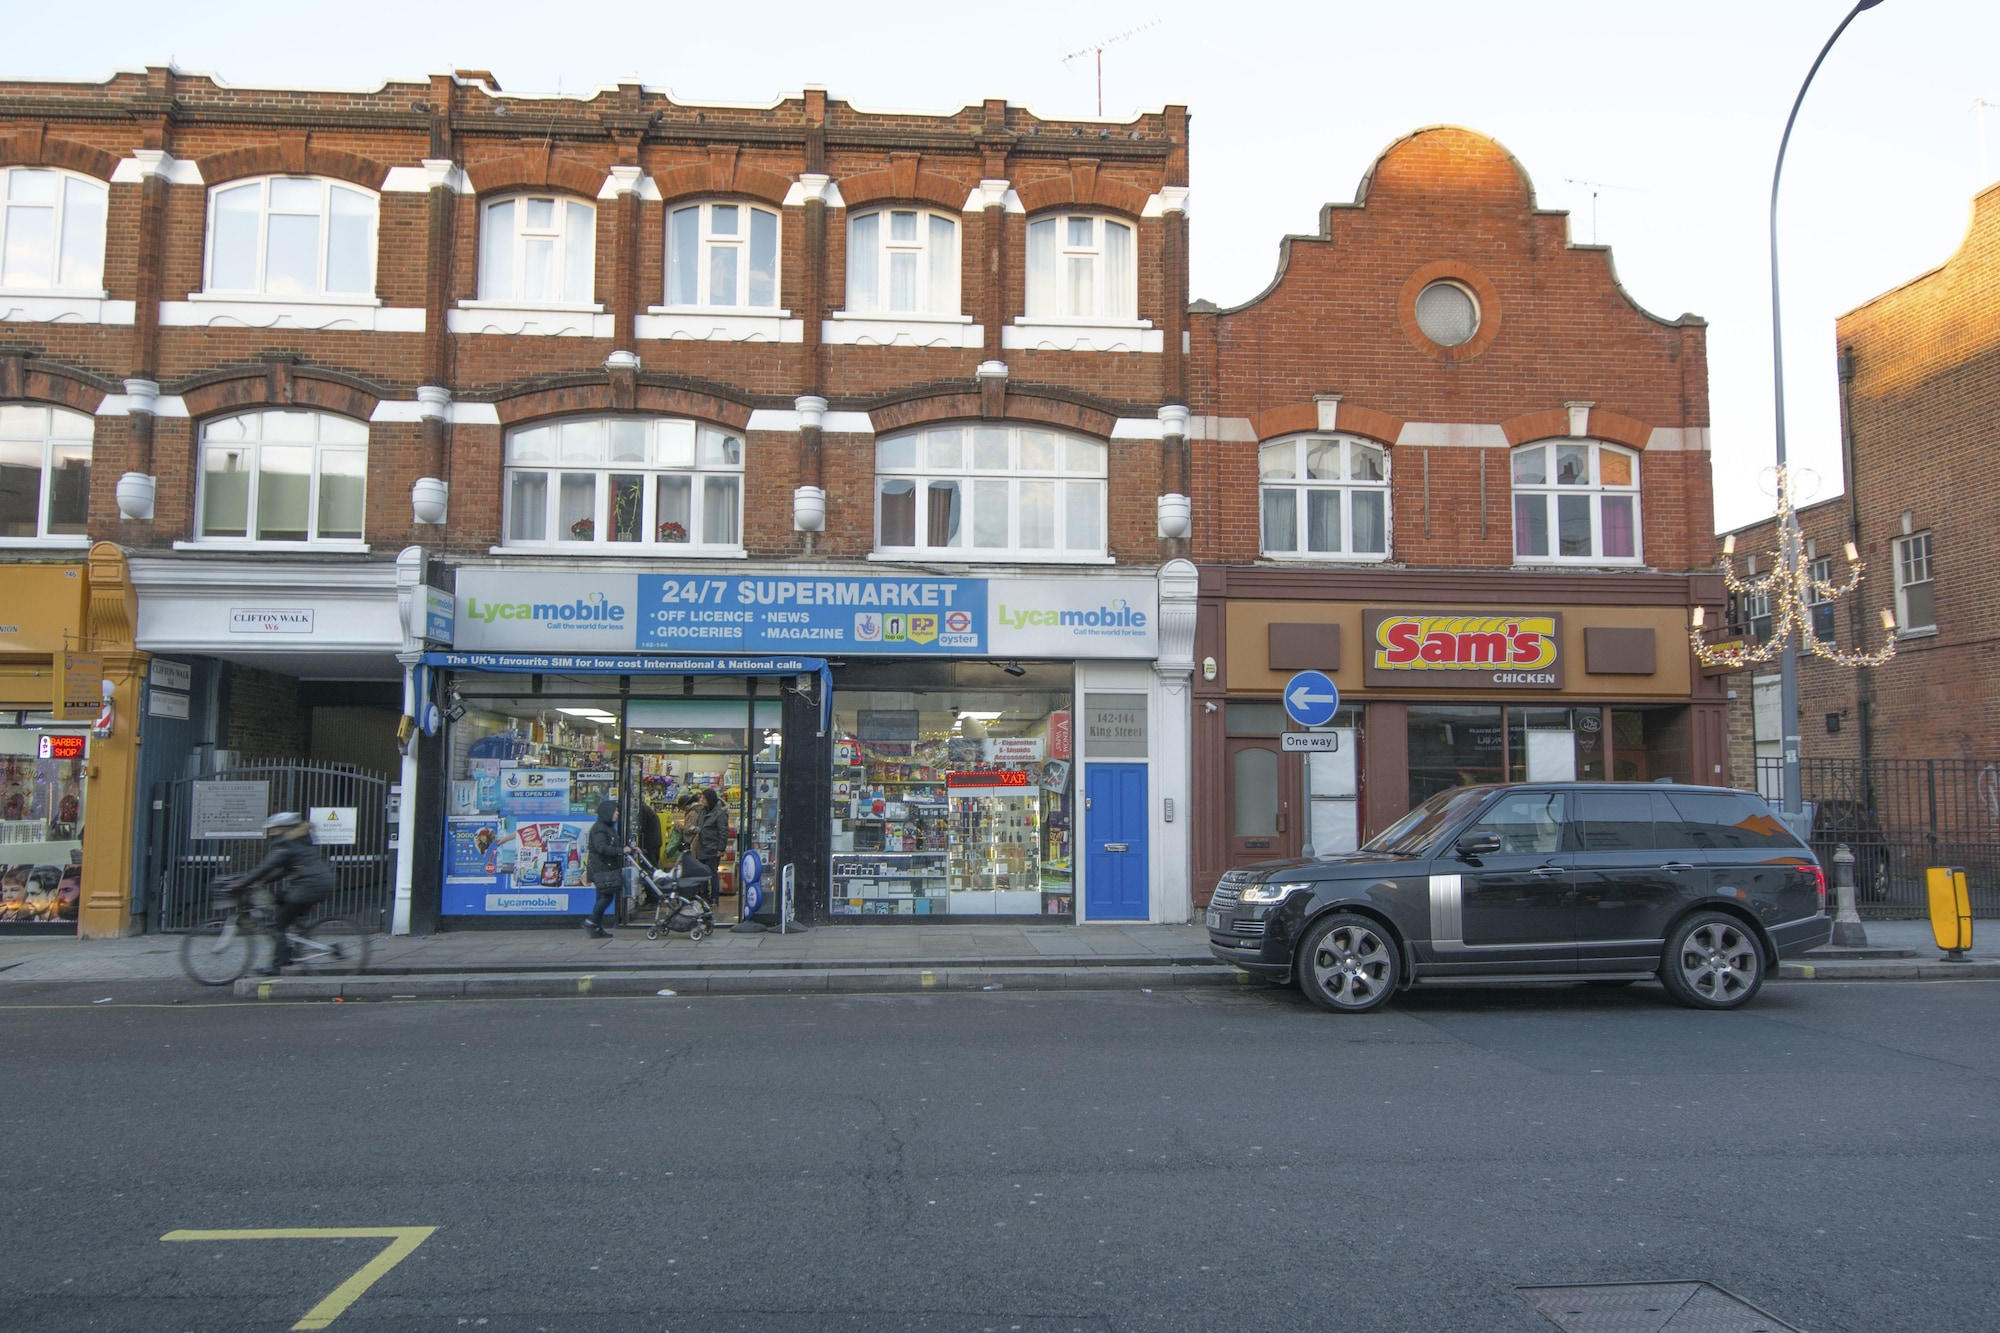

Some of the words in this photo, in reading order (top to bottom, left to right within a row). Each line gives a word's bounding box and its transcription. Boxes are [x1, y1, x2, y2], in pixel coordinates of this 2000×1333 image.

[662, 580, 727, 604] 24/7
[737, 581, 958, 606] SUPERMARKET
[467, 597, 625, 623] Lycamobile
[234, 614, 278, 622] CLIFTON
[280, 615, 308, 623] WALK
[657, 610, 686, 622] OFF
[690, 611, 754, 623] LICENCE
[767, 611, 810, 623] NEWS
[999, 604, 1146, 630] Lycamobile
[264, 623, 279, 631] W6
[547, 622, 562, 630] Call
[656, 626, 743, 638] GROCERIES
[767, 628, 844, 639] MAGAZINE
[940, 635, 974, 646] oyster
[1386, 622, 1543, 664] Sam's
[446, 655, 468, 664] The
[471, 656, 496, 665] UK's
[499, 656, 549, 666] favourite
[551, 657, 573, 667] SIM
[575, 657, 592, 667] for
[594, 658, 614, 667] low
[617, 660, 641, 668] cost
[644, 660, 714, 669] International
[717, 660, 726, 669] &
[728, 660, 774, 669] National
[776, 660, 803, 669] calls
[1493, 673, 1555, 684] CHICKEN
[1097, 713, 1135, 723] 142-144
[1090, 726, 1112, 738] King
[1114, 726, 1142, 737] Street
[50, 738, 82, 747] BARBER
[1286, 737, 1308, 746] One
[1310, 738, 1332, 748] way
[55, 748, 77, 757] SHOP
[1001, 773, 1026, 784] VAP
[497, 897, 557, 908] Lycamobile
